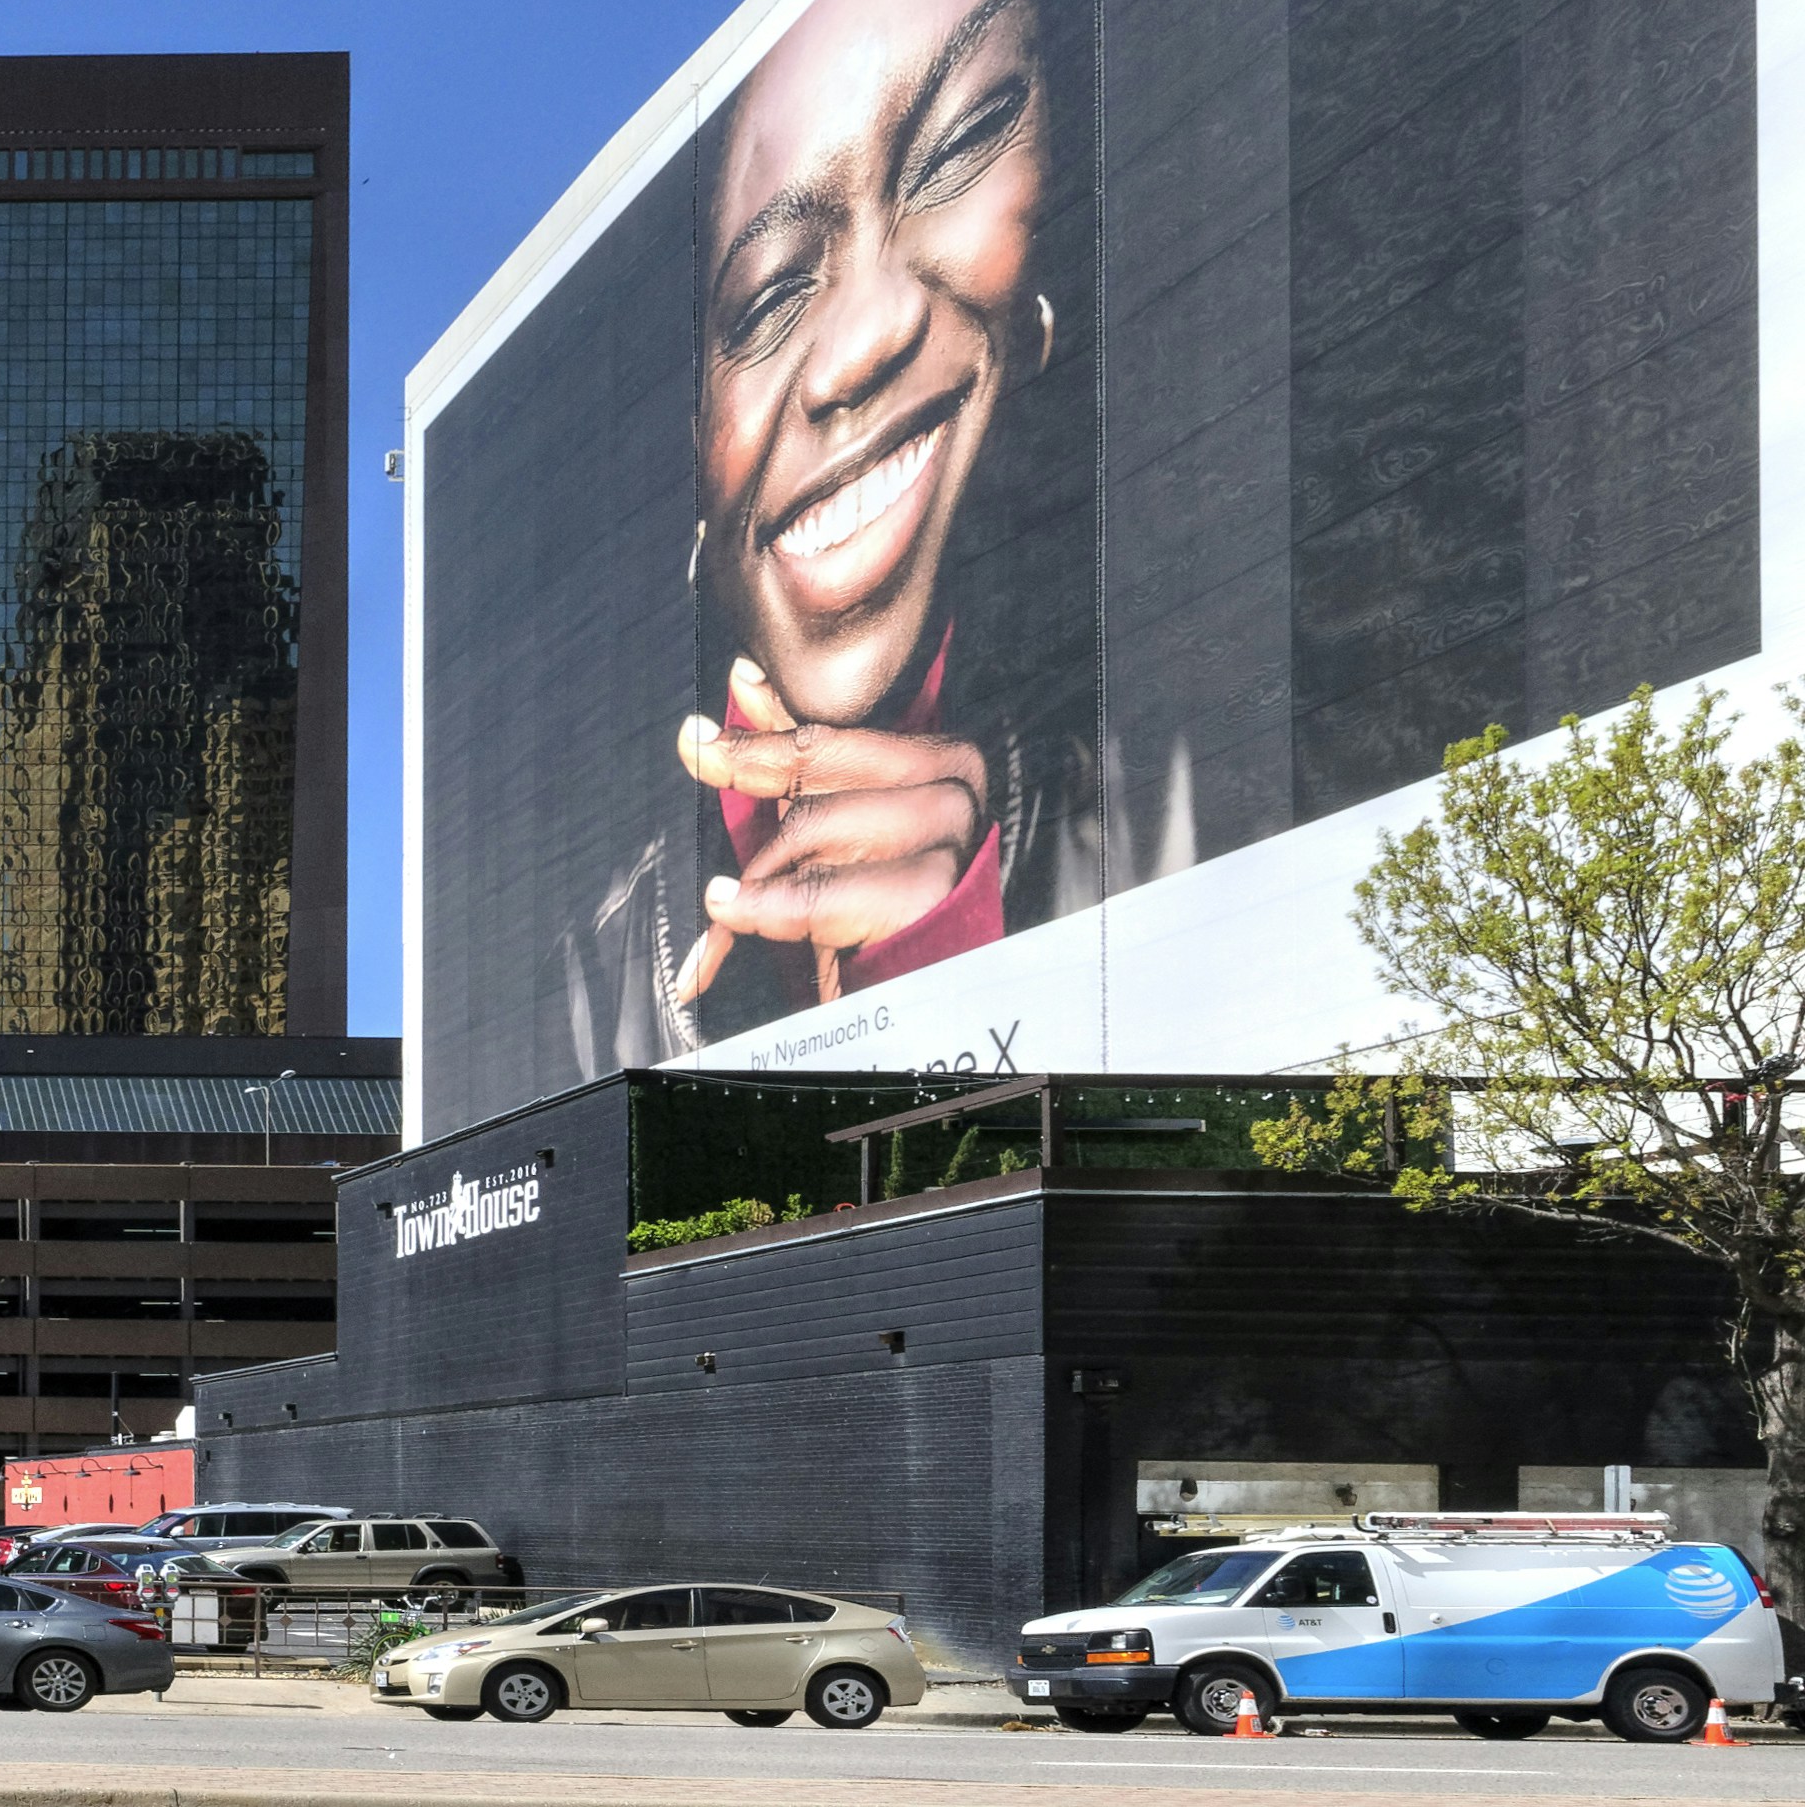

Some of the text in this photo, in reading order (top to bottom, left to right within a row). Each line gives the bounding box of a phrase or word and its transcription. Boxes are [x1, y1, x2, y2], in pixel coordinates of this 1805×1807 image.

[775, 1014, 868, 1067] Nyamuoch
[874, 1005, 895, 1031] G.
[988, 1019, 1021, 1074] X
